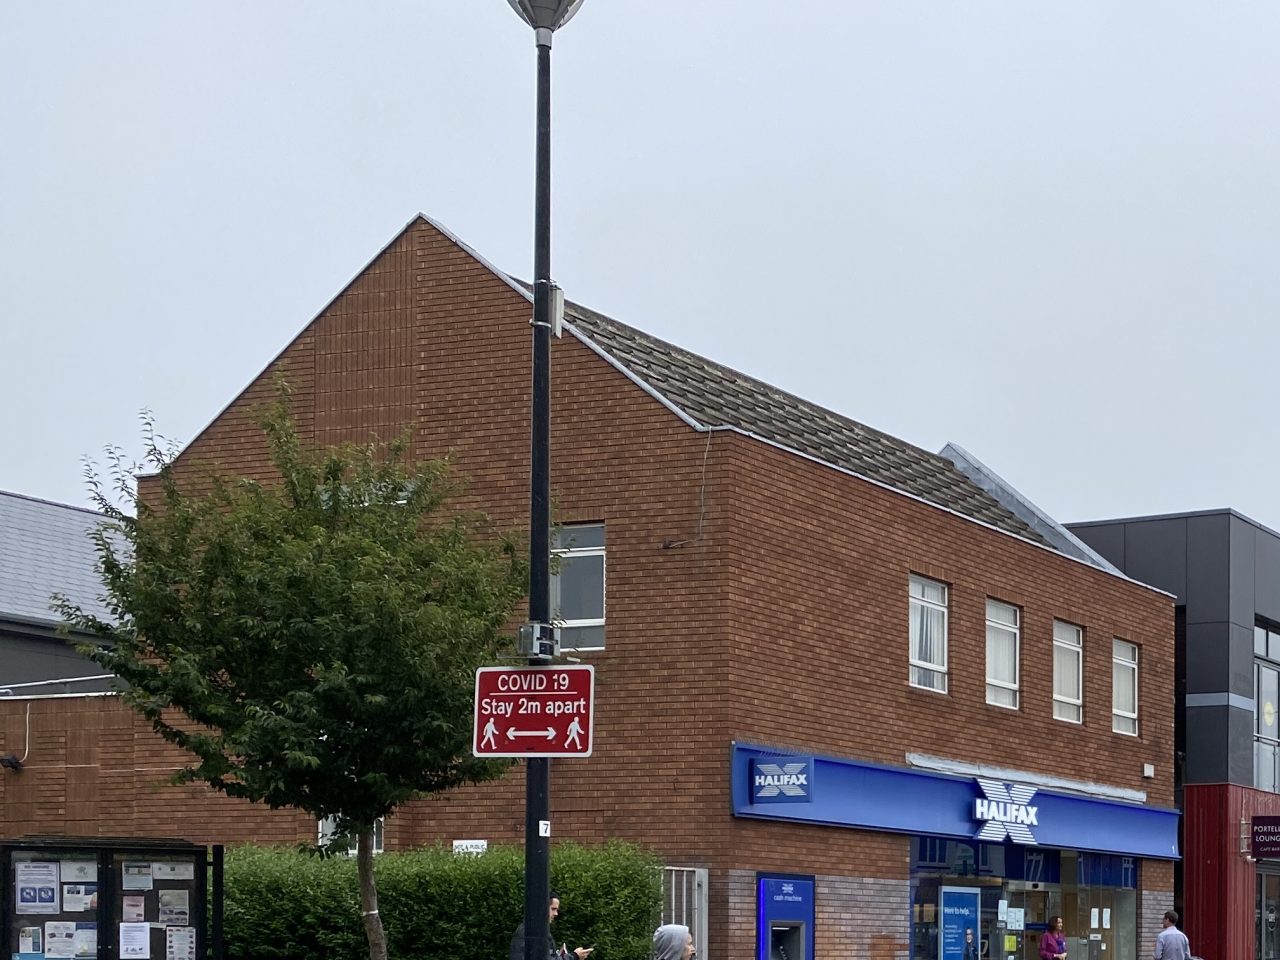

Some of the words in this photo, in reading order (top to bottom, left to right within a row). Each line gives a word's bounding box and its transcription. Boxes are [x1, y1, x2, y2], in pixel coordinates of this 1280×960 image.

[497, 674, 547, 691] COVID
[552, 673, 569, 690] 19
[481, 698, 514, 718] Stay
[518, 698, 541, 714] 2m
[545, 698, 586, 717] apart
[755, 774, 808, 786] HALIFAX
[976, 798, 1039, 826] HALIFAX
[543, 823, 549, 834] 7
